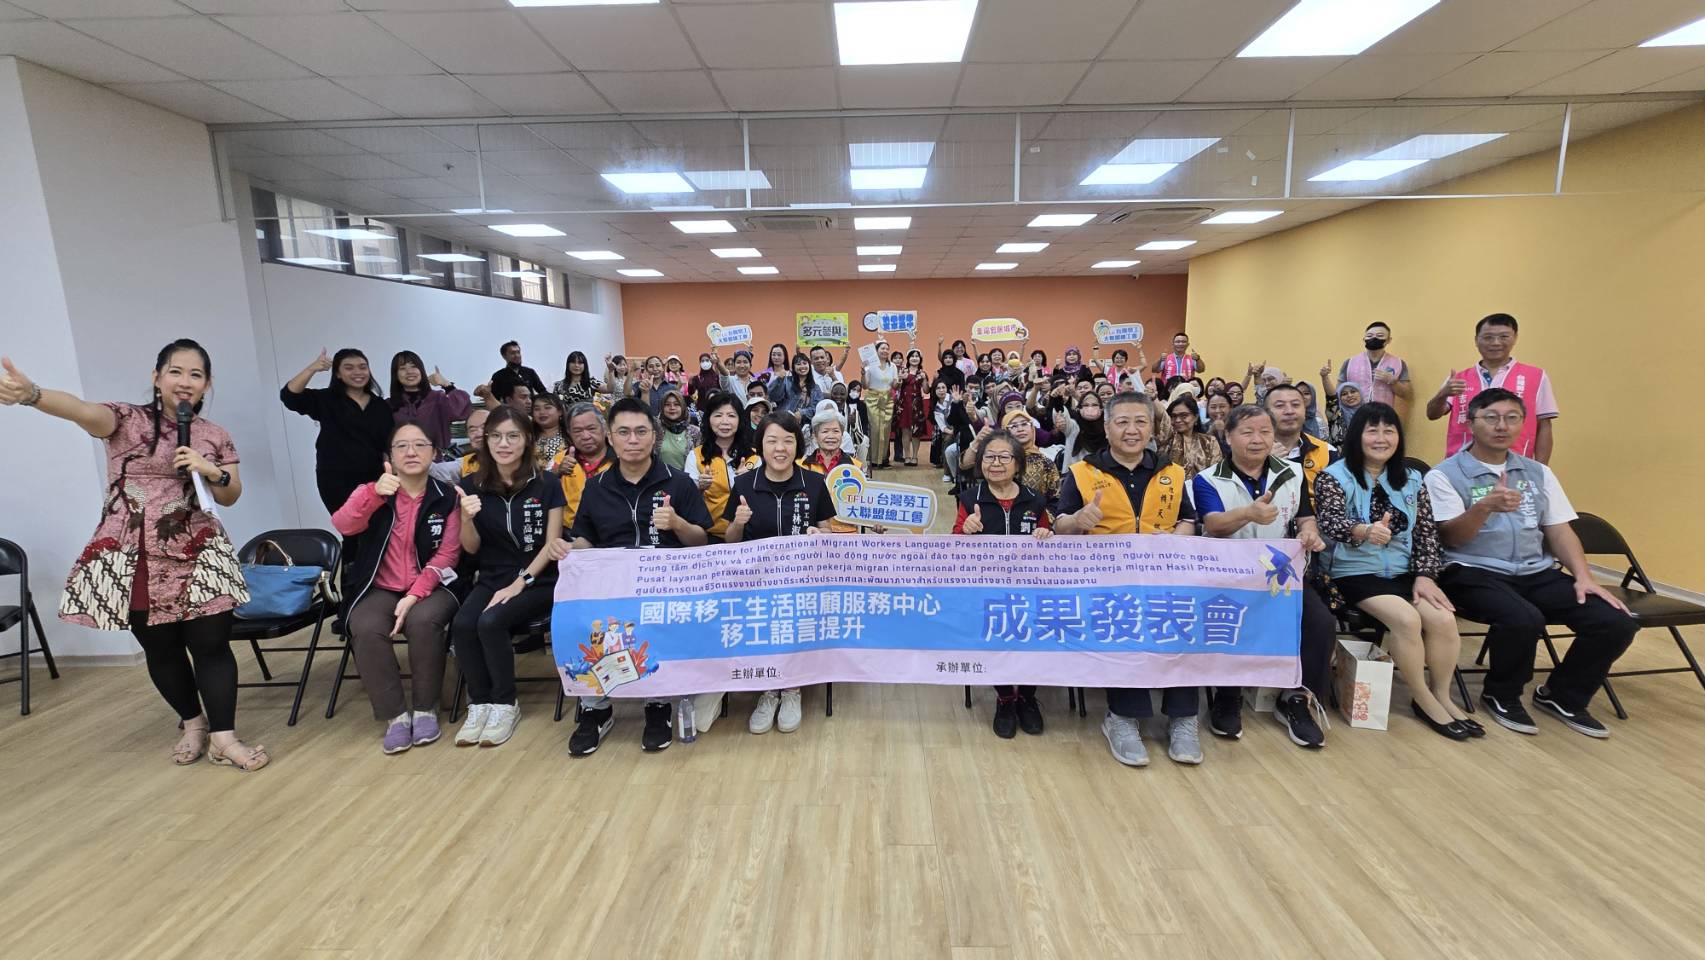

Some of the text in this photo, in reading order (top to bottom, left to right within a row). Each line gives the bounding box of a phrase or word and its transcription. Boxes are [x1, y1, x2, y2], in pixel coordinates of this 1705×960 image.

[846, 492, 929, 509] TFLU 台灣勞工
[846, 506, 924, 524] 大聯盟總工會
[706, 549, 736, 557] Center
[758, 540, 818, 551] International
[822, 540, 858, 548] Migrant
[906, 541, 952, 549] Language
[794, 551, 822, 560] người
[844, 551, 868, 560] động
[670, 572, 708, 583] layanan
[712, 568, 760, 580] perawatan
[764, 564, 814, 575] kehidupan
[817, 563, 852, 571] pekerja
[856, 564, 888, 572] migran
[980, 564, 1040, 573] peringkatan
[1044, 565, 1079, 573] bahasa
[1084, 564, 1122, 573] pekerja
[1126, 564, 1162, 572] migran
[1166, 563, 1194, 571] Hasil
[1198, 564, 1255, 575] Presentasi
[639, 592, 942, 626] 國際移工生活照顧服務中心
[982, 593, 1249, 646] 成果發表會
[720, 616, 866, 649] 移工語言提升
[732, 666, 782, 680] 主辦單位:
[936, 662, 987, 674] 承辦單位:
